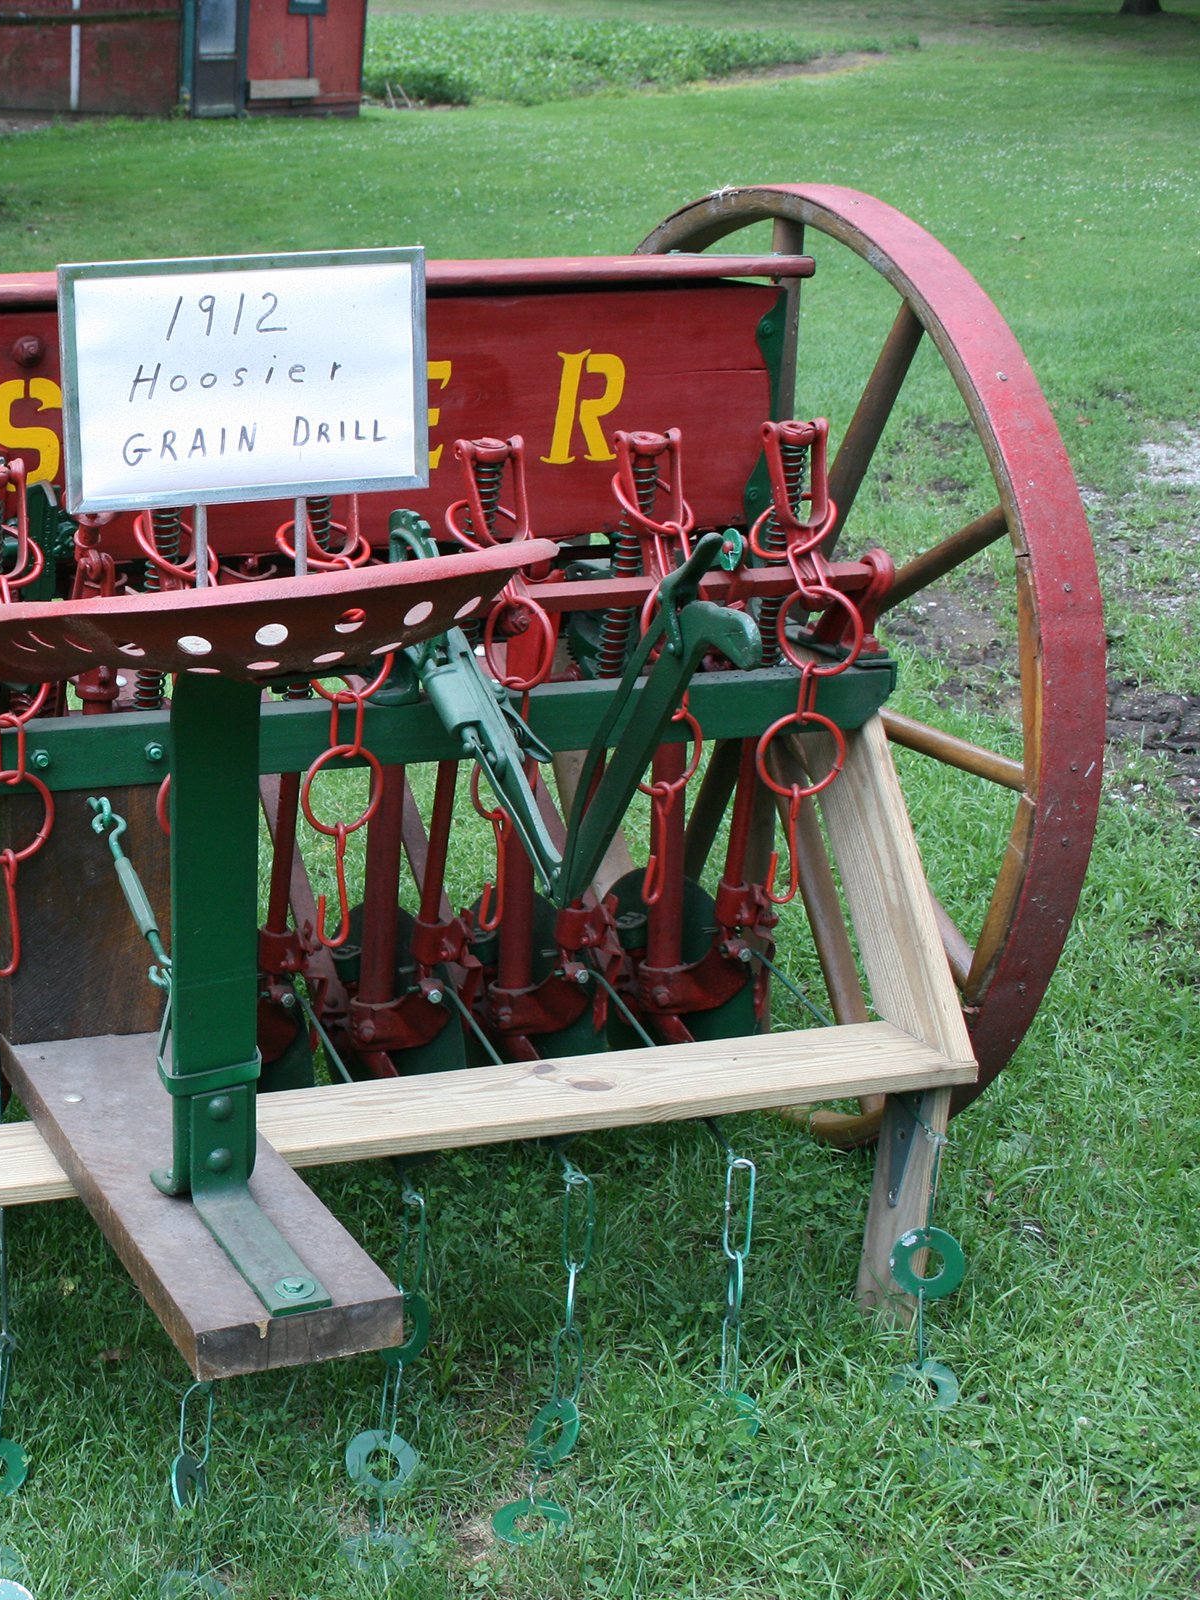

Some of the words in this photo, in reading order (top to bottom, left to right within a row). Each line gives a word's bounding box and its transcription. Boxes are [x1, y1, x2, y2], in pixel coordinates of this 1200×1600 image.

[165, 292, 288, 341] 1912
[128, 354, 342, 402] Hoosier
[122, 421, 258, 467] GRAIN
[292, 414, 388, 448] DRILL
